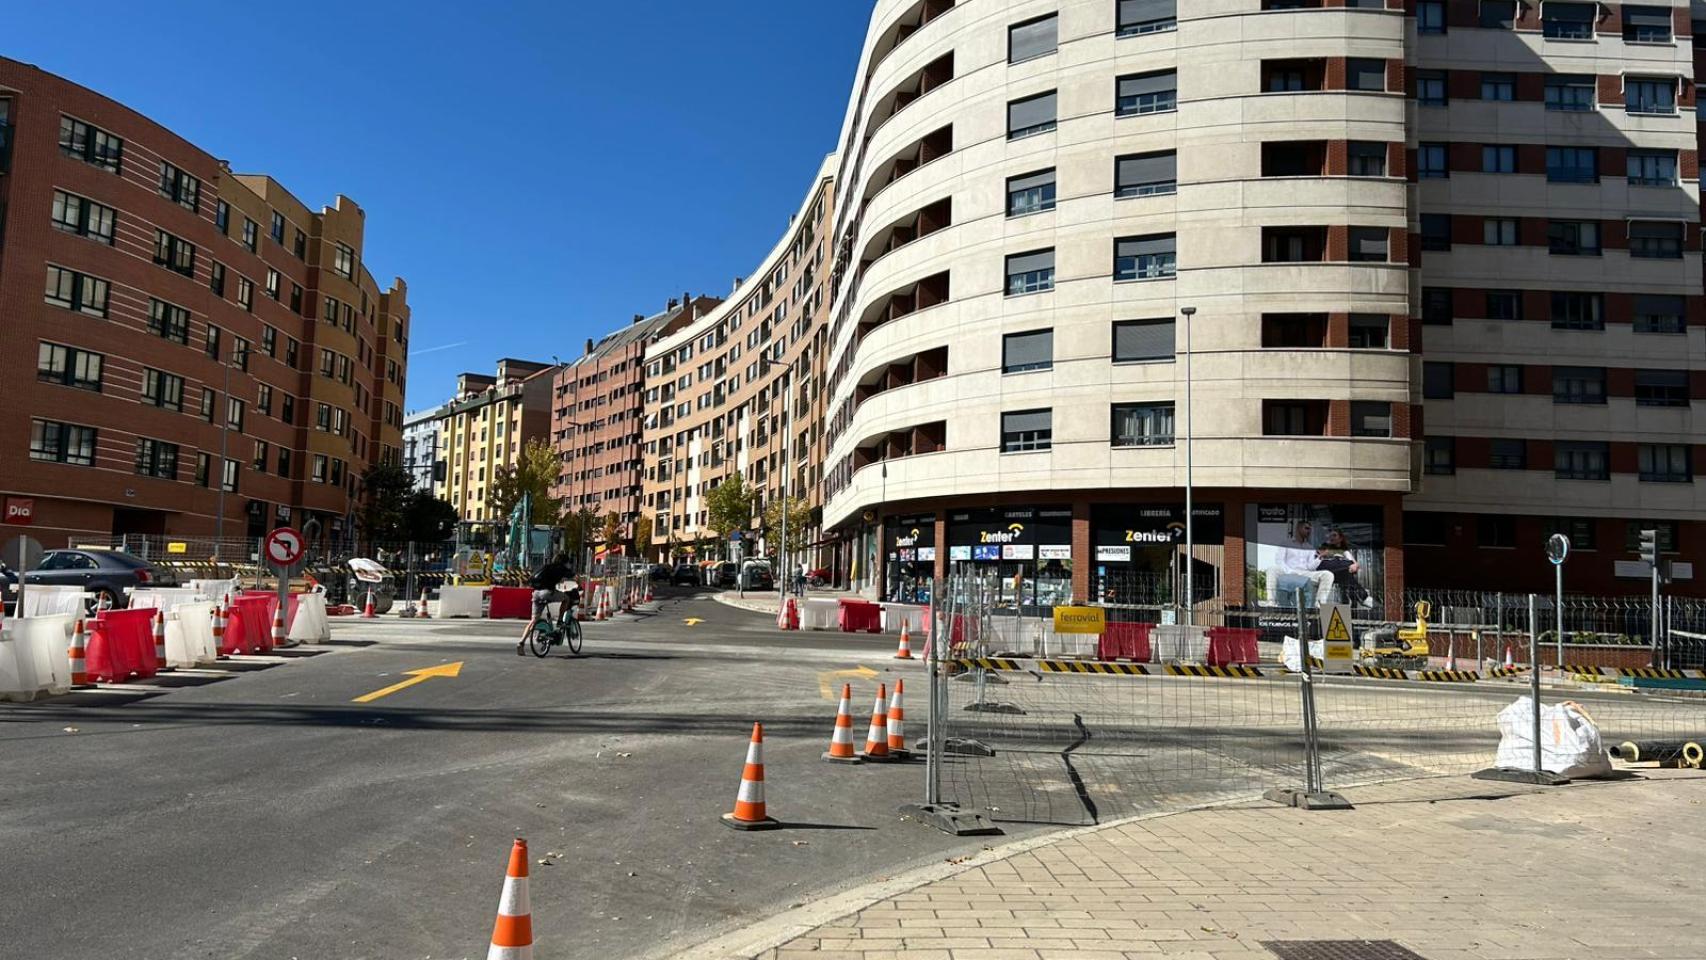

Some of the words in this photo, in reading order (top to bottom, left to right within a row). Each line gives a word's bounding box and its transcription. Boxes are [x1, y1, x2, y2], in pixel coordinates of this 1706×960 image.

[980, 531, 1013, 543] Zenter
[1125, 529, 1172, 542] Zenter
[1060, 611, 1100, 622] ferrovial
